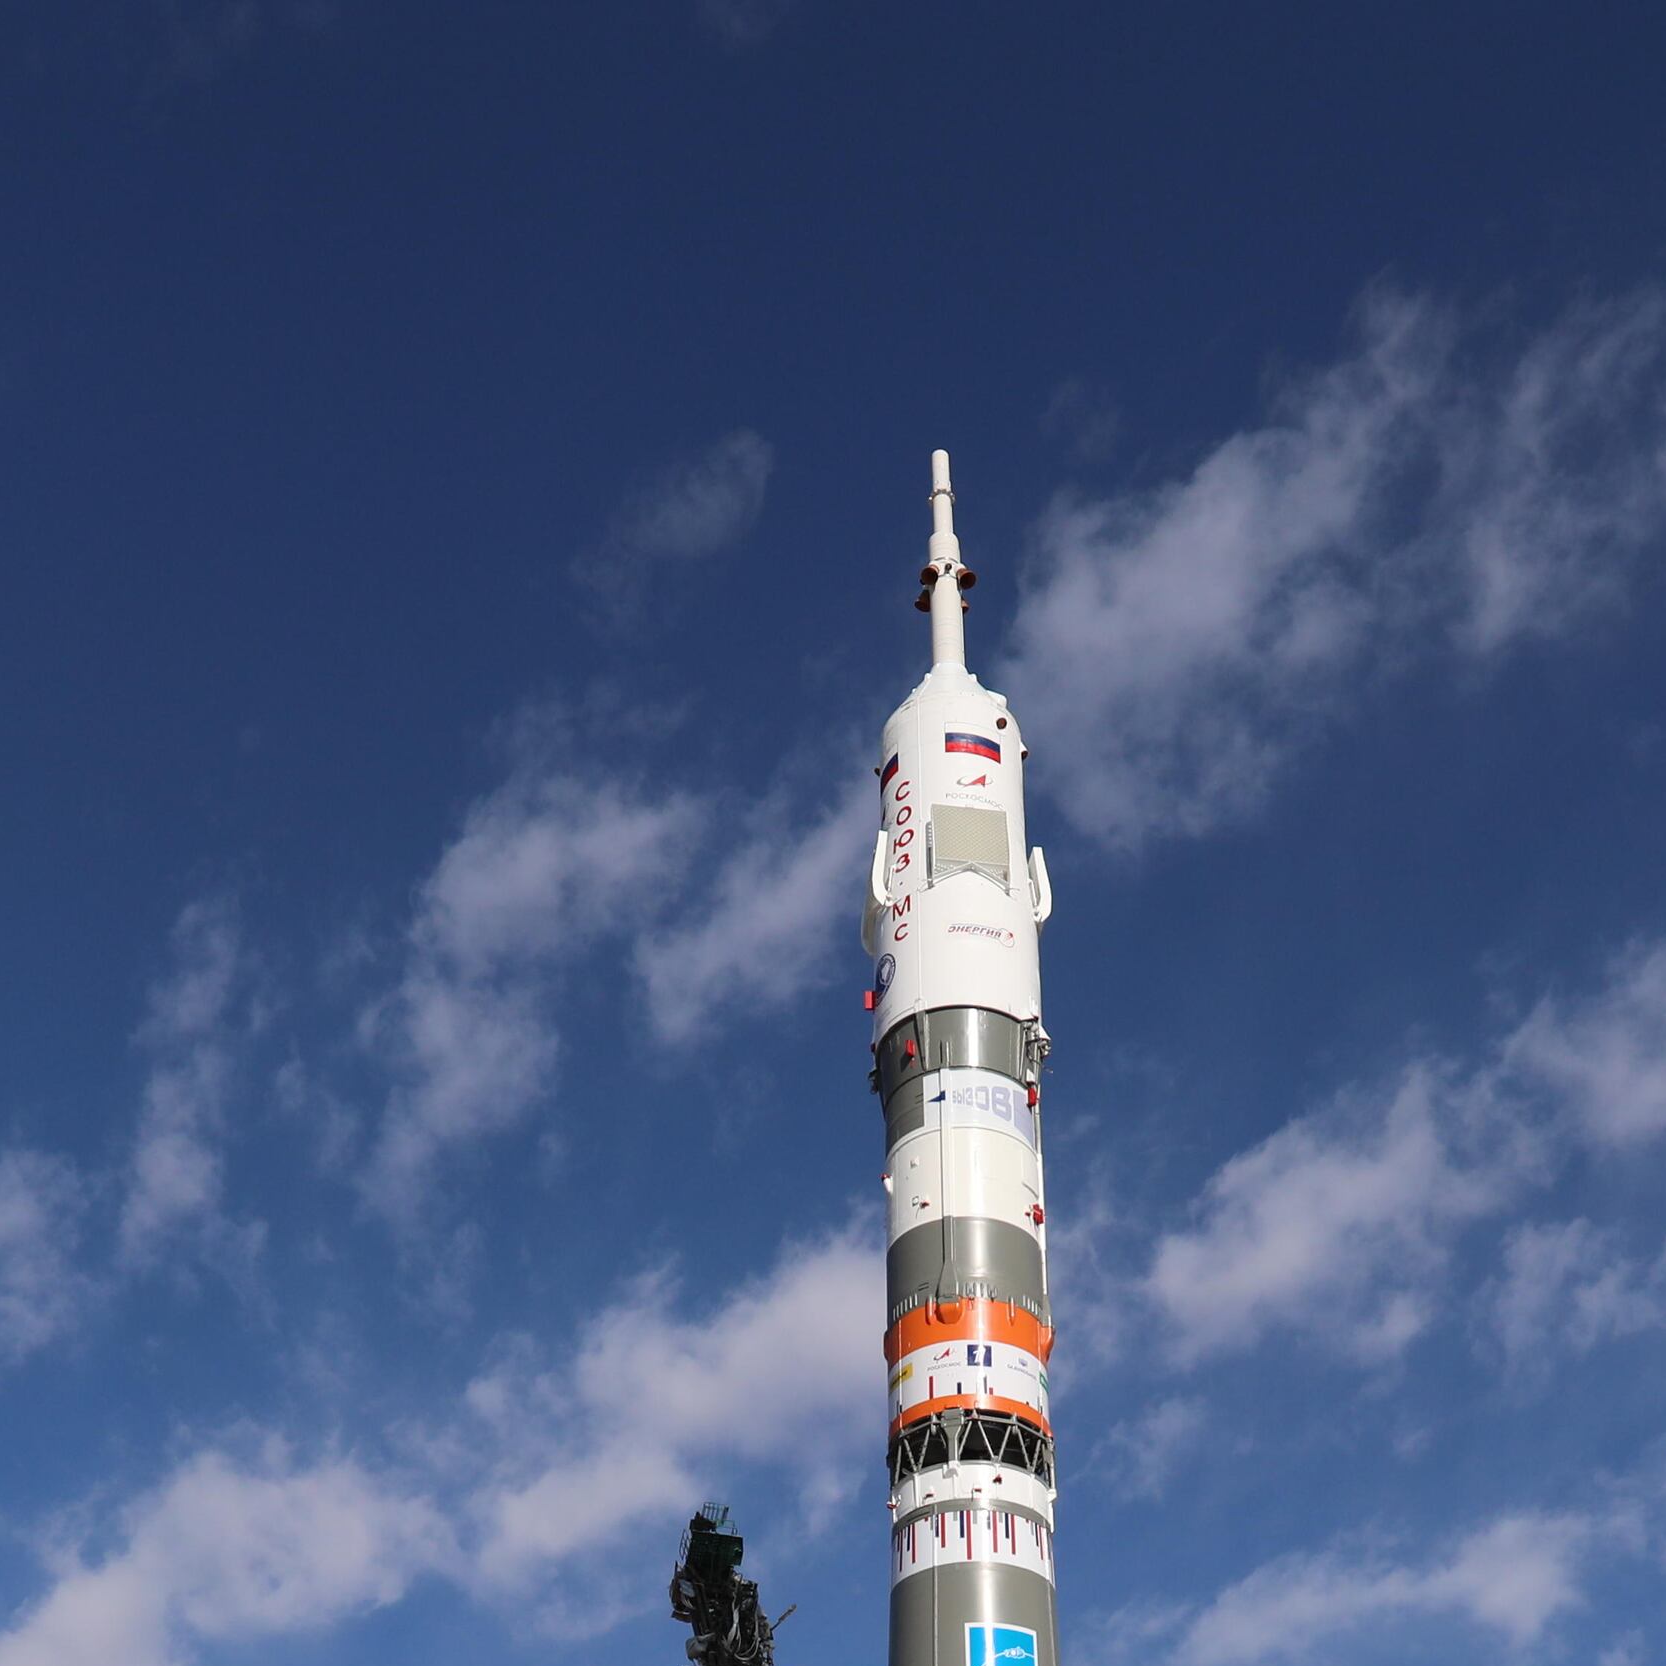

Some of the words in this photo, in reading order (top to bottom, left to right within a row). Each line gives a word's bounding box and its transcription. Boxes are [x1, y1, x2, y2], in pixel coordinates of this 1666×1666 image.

[893, 781, 914, 873] СОЮЗ
[892, 895, 911, 941] МС
[948, 925, 1002, 938] ЭНЕРГИЯ
